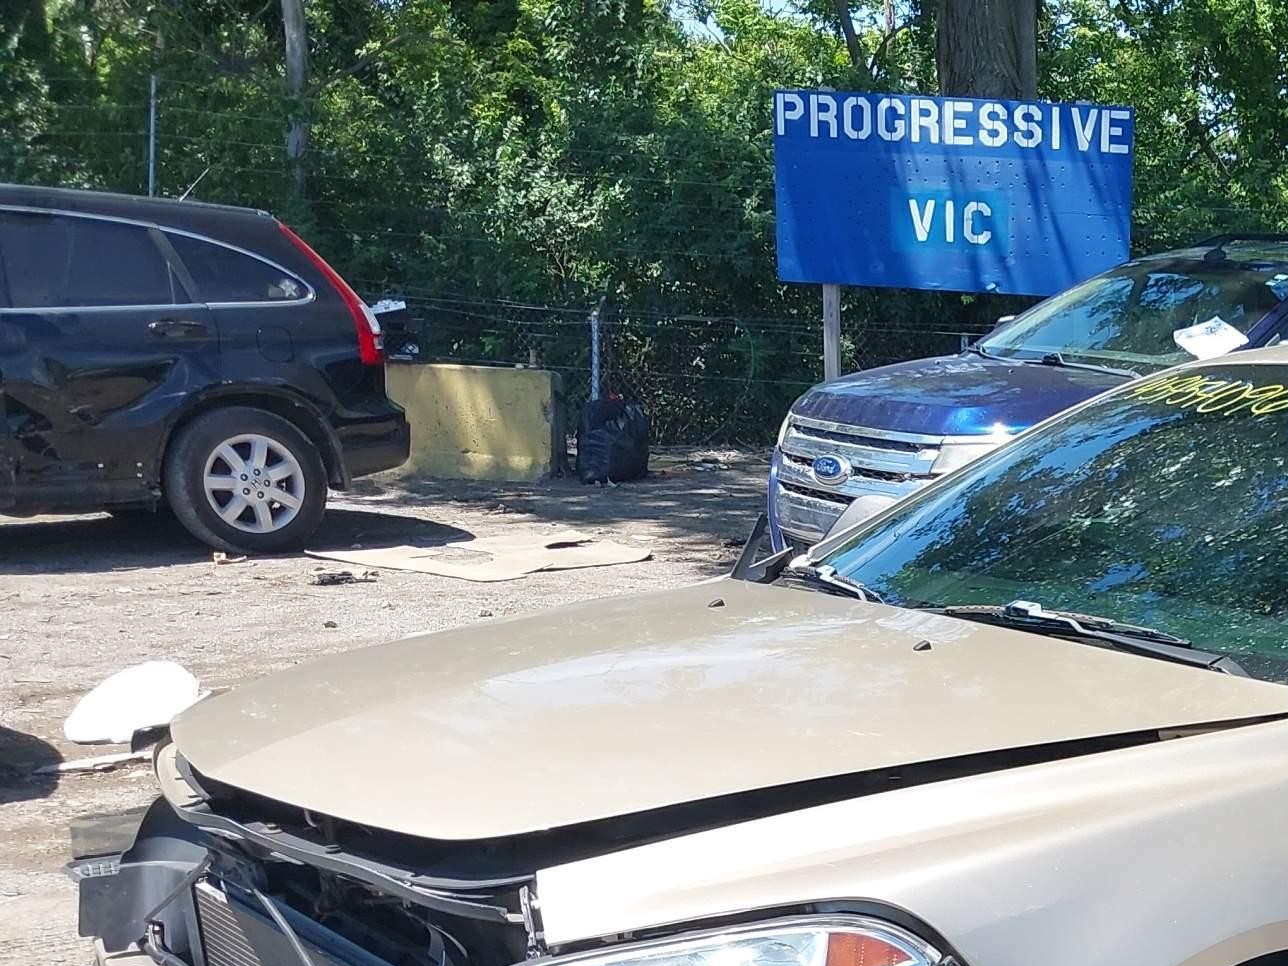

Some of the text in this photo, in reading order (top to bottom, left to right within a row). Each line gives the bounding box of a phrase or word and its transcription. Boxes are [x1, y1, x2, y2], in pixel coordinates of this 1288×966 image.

[775, 93, 1131, 154] PROGRESSIVE
[908, 199, 993, 245] VIC
[816, 458, 837, 475] Ford
